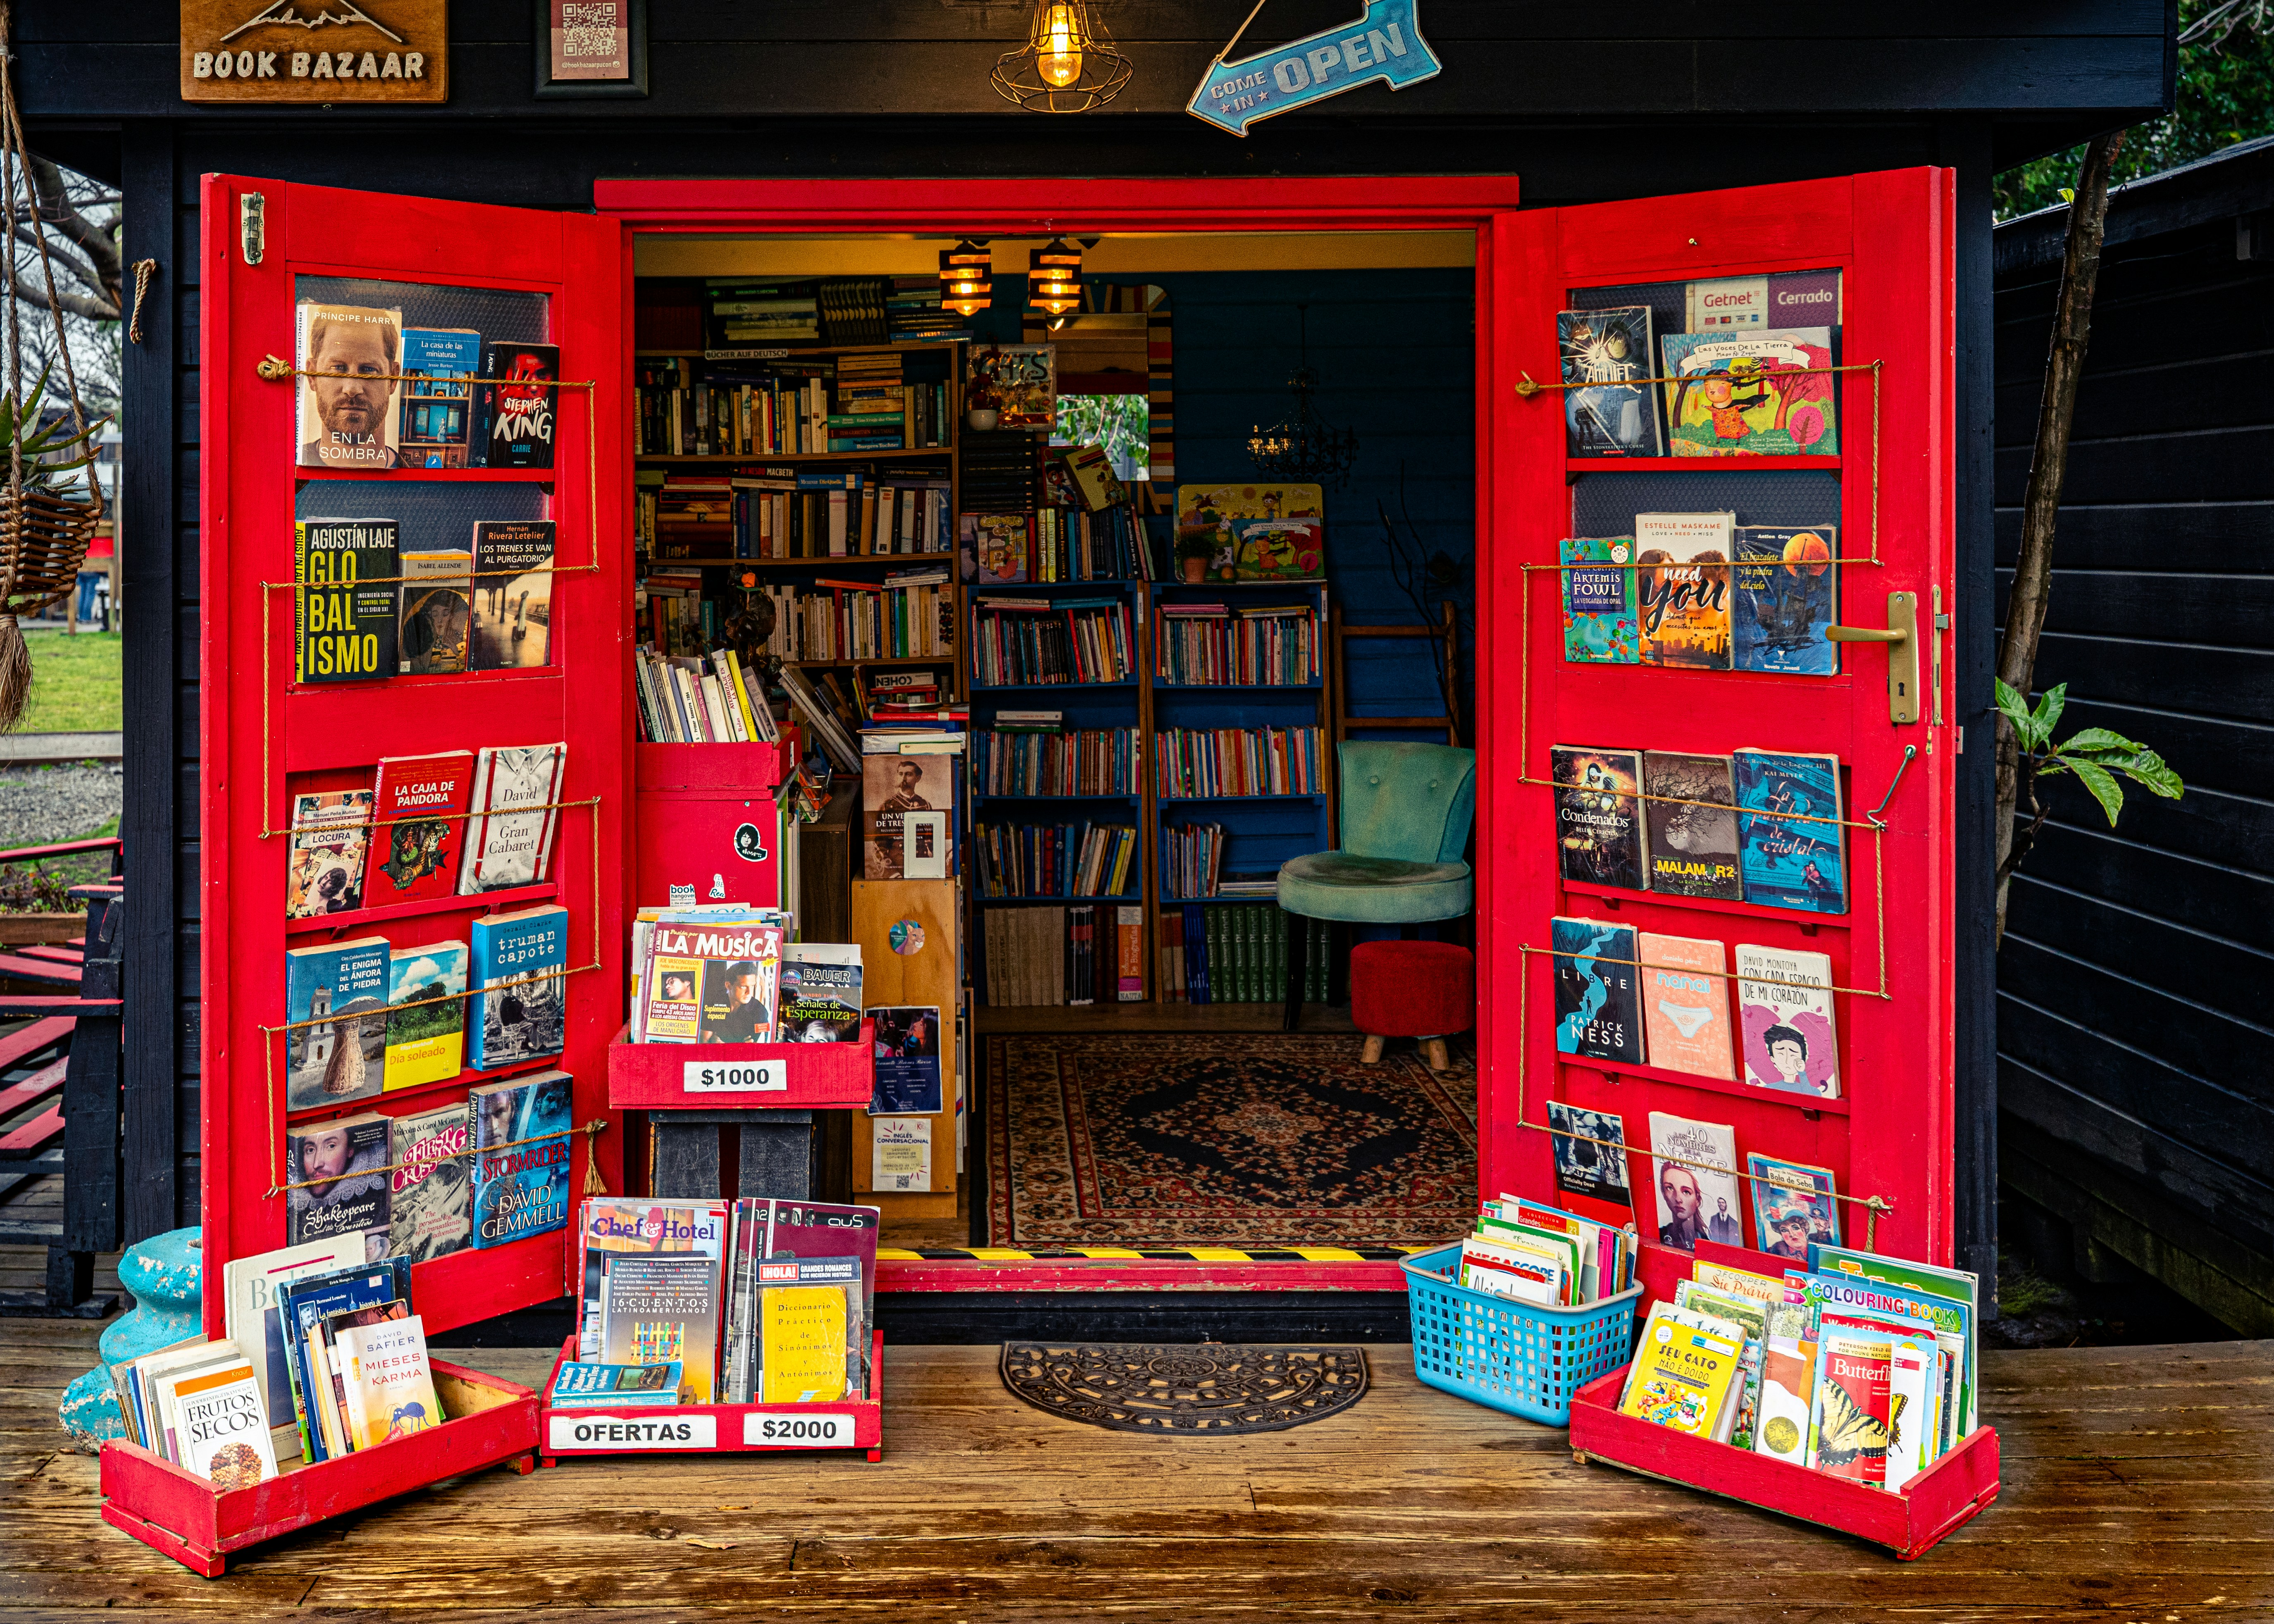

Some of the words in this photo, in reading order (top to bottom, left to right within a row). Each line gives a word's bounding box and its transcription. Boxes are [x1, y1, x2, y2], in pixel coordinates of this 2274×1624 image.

[193, 51, 278, 78] BOOK
[291, 51, 424, 79] BAZAAR
[1273, 22, 1407, 94] OPEN
[1211, 71, 1266, 100] COME
[1235, 94, 1254, 112] IN
[1704, 291, 1752, 307] Getnet
[1778, 290, 1832, 305] Cerrado
[314, 311, 361, 322] PRÍNCIPE
[364, 316, 396, 325] HARRY
[426, 350, 456, 359] miniaturas
[707, 349, 734, 358] BÜCHER
[1698, 345, 1711, 353] Las
[1714, 344, 1735, 352] Voces
[504, 398, 548, 414] STEPHEN
[493, 412, 553, 444] KING
[331, 432, 353, 445] EN
[357, 433, 376, 445] LA
[319, 447, 386, 461] SOMBRA
[512, 444, 531, 453] CARRIE
[766, 467, 793, 477] MACBETH
[311, 524, 366, 549] AGUSTÍN
[369, 528, 394, 548] LAJE
[479, 545, 493, 553] LOS
[496, 544, 523, 552] TRENES
[536, 544, 551, 552] VAN
[485, 555, 495, 563] AL
[497, 554, 545, 563] PURGATORIO
[1573, 572, 1620, 583] ARTEMIS
[1574, 584, 1620, 595] FOWL
[309, 593, 356, 632] BAL
[309, 634, 377, 674] ISMO
[876, 676, 911, 686] COHEN
[394, 786, 408, 796] LA
[411, 783, 437, 795] CAJA
[441, 781, 454, 791] DE
[503, 786, 537, 803] David
[397, 793, 448, 807] PANDORA
[1562, 808, 1631, 828] Condenados
[312, 833, 351, 843] LOCURA
[500, 826, 528, 840] Gran
[489, 839, 534, 855] Cabaret
[671, 885, 695, 895] book
[503, 925, 526, 933] Gerald
[529, 920, 552, 929] Clarke
[498, 930, 556, 950] truman
[661, 930, 689, 955] LA
[694, 931, 779, 957] MÚSICA
[498, 944, 554, 964] capote
[341, 963, 349, 972] EL
[352, 958, 382, 971] ENIGMA
[1744, 955, 1763, 967] DAVID
[1767, 959, 1797, 971] MONTOYA
[351, 969, 381, 980] ÁNFORA
[803, 969, 851, 982] BAUER
[1562, 969, 1628, 989] LIBRE
[338, 983, 349, 992] DE
[353, 978, 381, 990] PIEDRA
[1657, 973, 1710, 993] nanai
[1745, 985, 1755, 998] DE
[1758, 988, 1768, 1000] MI
[1771, 987, 1807, 1006] CORAZÓN
[796, 999, 827, 1009] Señales
[830, 1000, 840, 1009] de
[786, 1006, 850, 1021] Esperanza
[1571, 1015, 1623, 1033] PATRICK
[1571, 1024, 1624, 1048] NESS
[390, 1053, 404, 1065] Día
[408, 1045, 446, 1062] soleado
[701, 1069, 770, 1086] $1000
[1687, 1126, 1707, 1143] 40
[1667, 1133, 1716, 1154] NOMBRES
[483, 1143, 566, 1182] STORMRIDER
[1563, 1176, 1583, 1186] Officially
[1584, 1180, 1595, 1188] Dead
[1770, 1173, 1784, 1182] Bola
[1796, 1177, 1812, 1188] Sebo
[498, 1185, 551, 1215] DAVID
[305, 1202, 375, 1229] Shakespeare
[481, 1202, 564, 1239] GEMMELL
[755, 1209, 767, 1221] 12
[593, 1218, 641, 1240] Chef
[644, 1222, 661, 1238] &
[661, 1219, 715, 1240] Hotel
[1519, 1215, 1540, 1226] Grandes
[1541, 1221, 1566, 1233] Aventuras
[1569, 1225, 1577, 1234] 23
[762, 1266, 796, 1279] ¡HOLA!
[800, 1264, 822, 1273] GRANDES
[777, 1303, 832, 1312] Diccionario
[1811, 1282, 1905, 1313] COLOURING
[1909, 1301, 1956, 1325] BOOK
[778, 1317, 832, 1326] Práctico
[366, 1336, 415, 1352] SAFIER
[377, 1331, 401, 1341] DAVID
[778, 1343, 832, 1351] Sinónimos
[366, 1353, 421, 1370] MIESES
[1658, 1345, 1680, 1360] SEU
[1684, 1352, 1717, 1371] GATO
[231, 1369, 248, 1379] Knaur
[779, 1369, 833, 1378] Antónimos
[1659, 1357, 1674, 1370] NÃO
[1677, 1362, 1683, 1373] É
[1686, 1364, 1709, 1381] DOIDO
[372, 1369, 422, 1386] KARMA
[187, 1391, 255, 1422] FRUTOS
[191, 1411, 259, 1444] SECOS
[575, 1423, 691, 1441] OFERTAS
[763, 1420, 837, 1439] $2000
